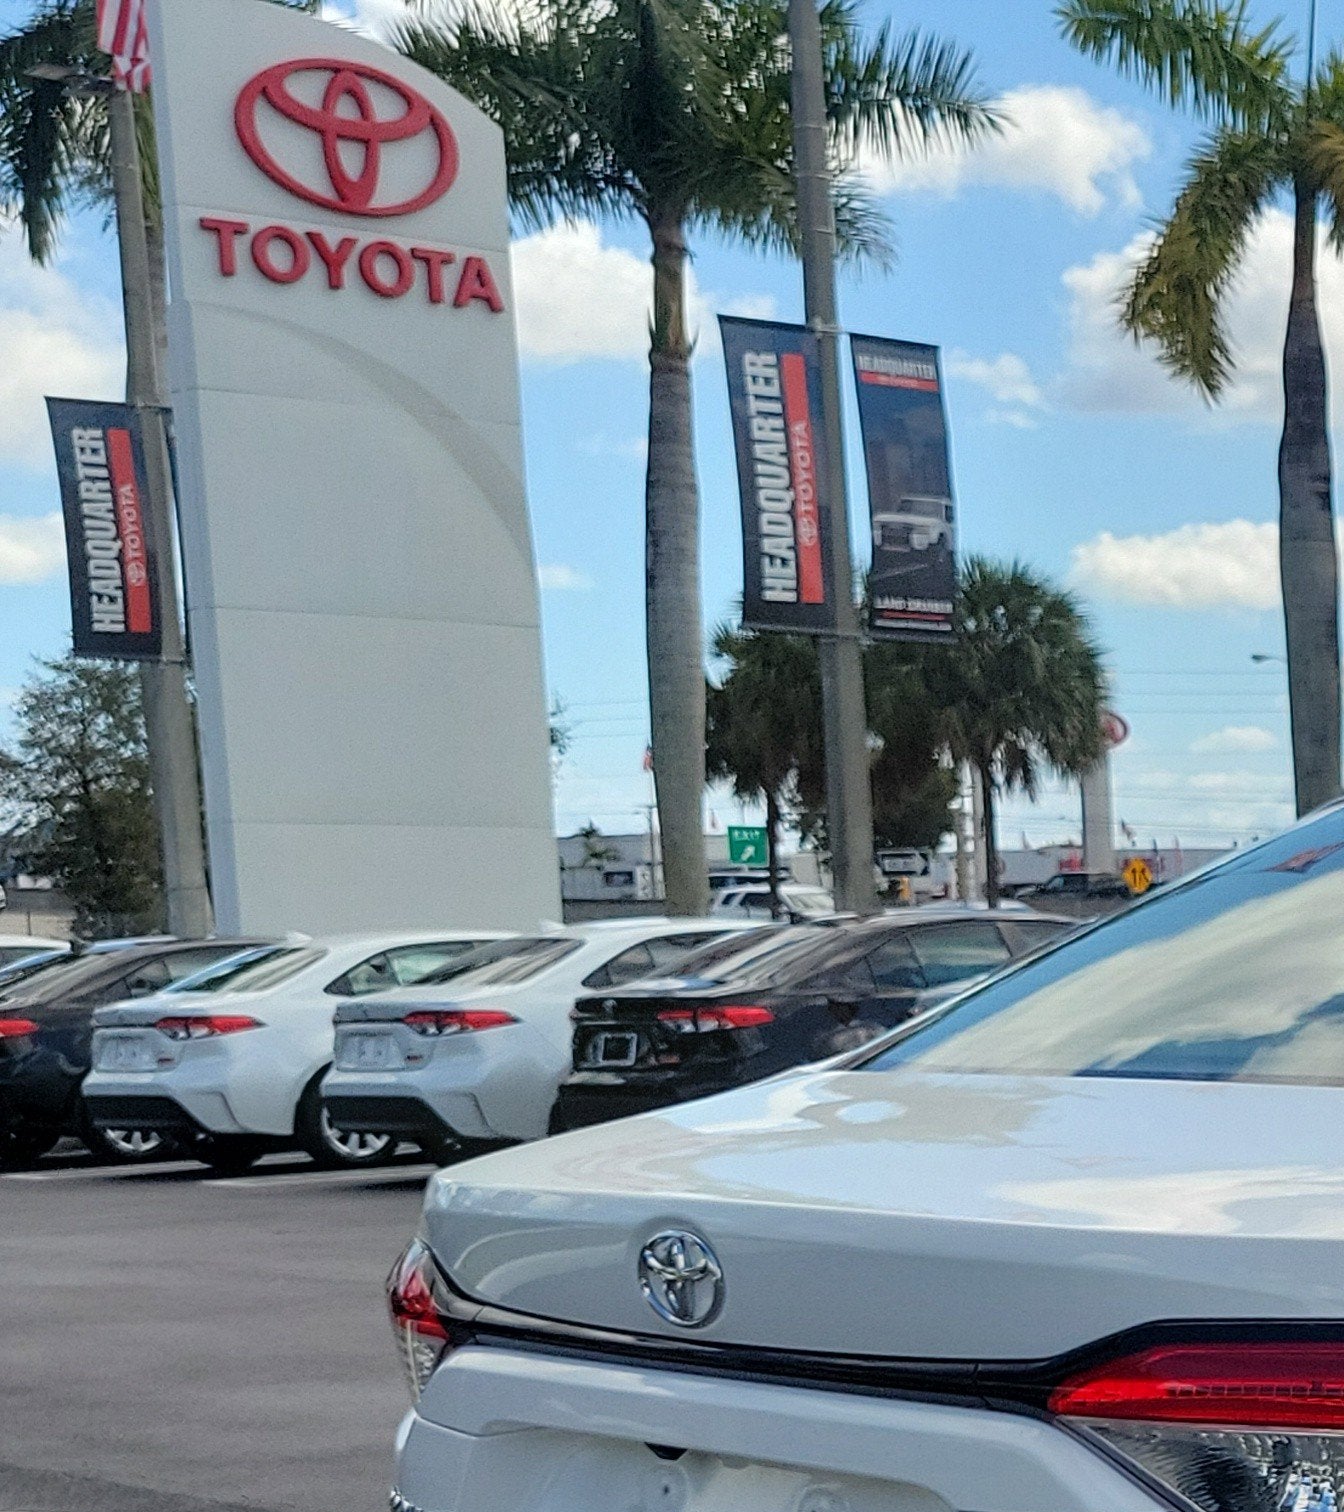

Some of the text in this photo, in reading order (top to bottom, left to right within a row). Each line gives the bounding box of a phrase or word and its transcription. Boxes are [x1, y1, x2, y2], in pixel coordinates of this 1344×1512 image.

[199, 216, 504, 313] TOYOTA
[743, 350, 798, 604] HEADQUARTER
[790, 420, 818, 508] TOYOTA
[72, 427, 126, 633] HEADQUARTER
[117, 483, 147, 560] TOYOTA
